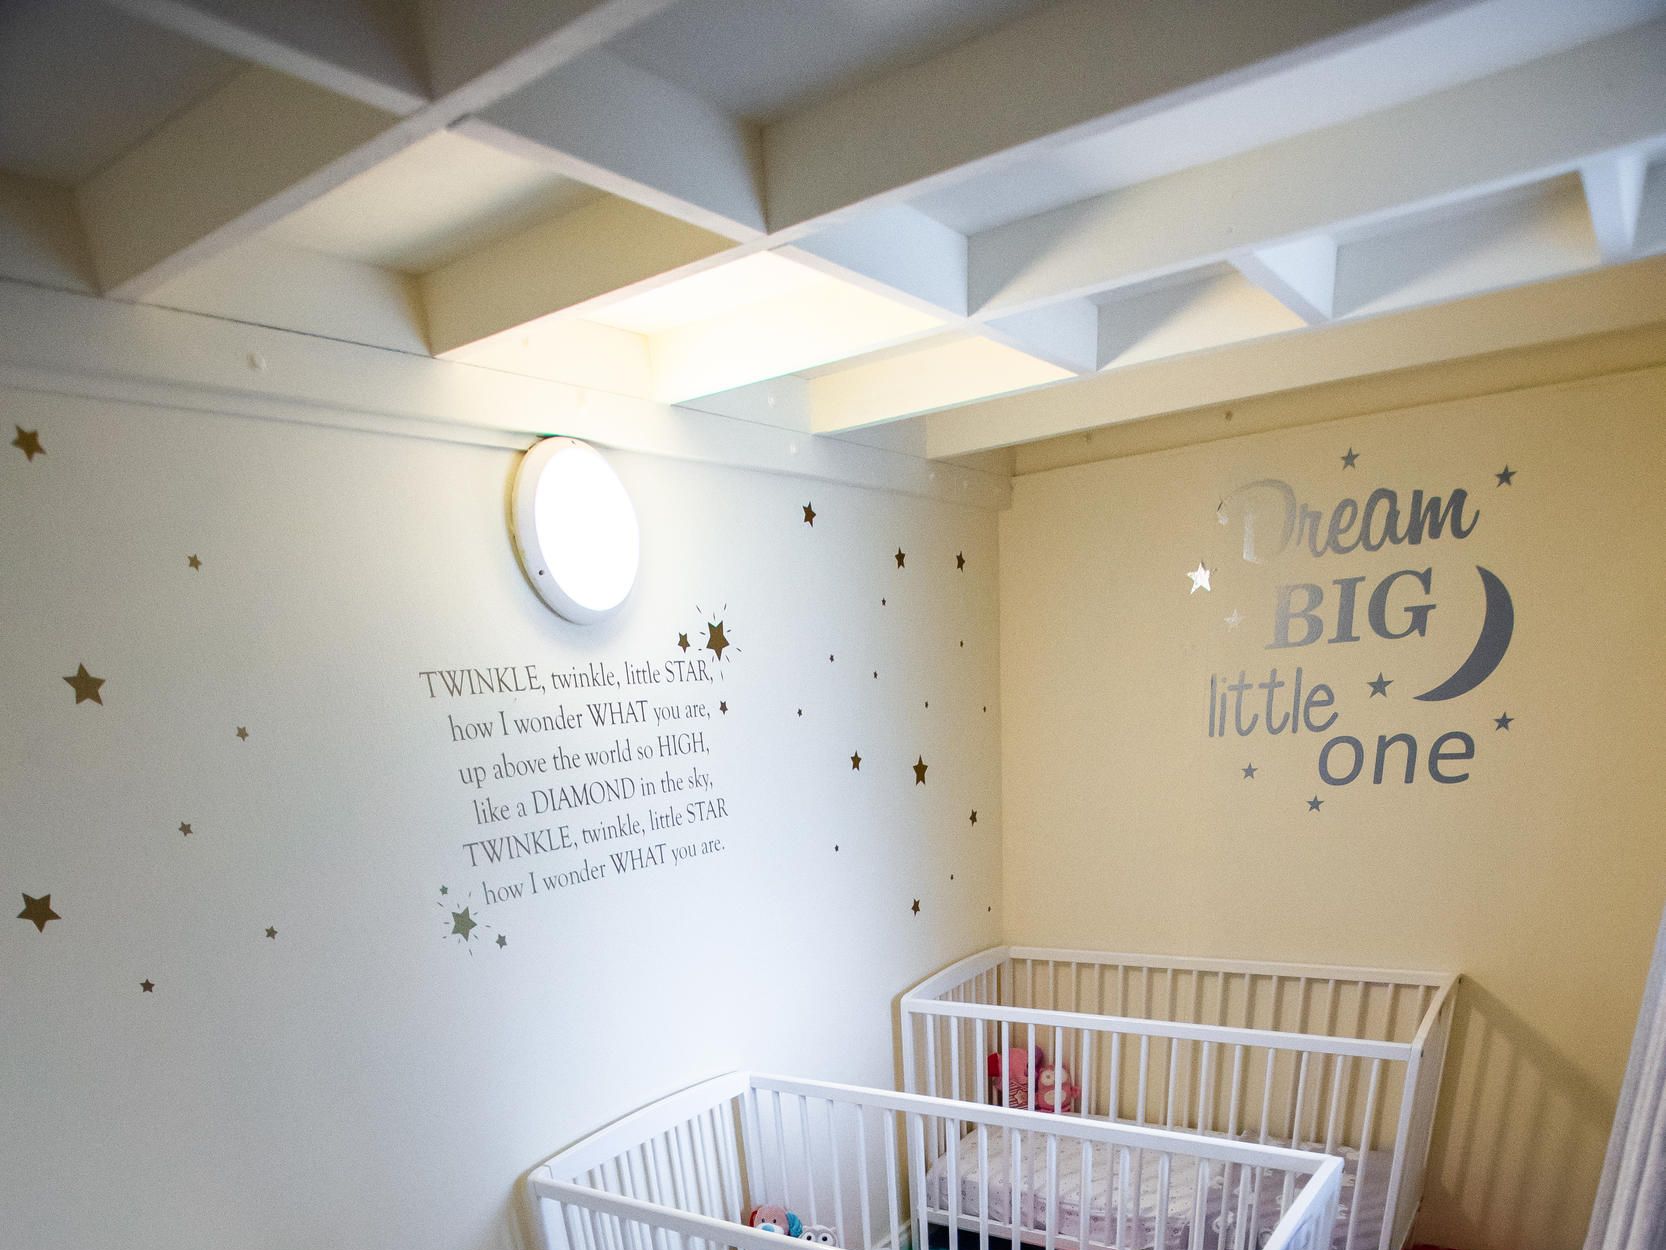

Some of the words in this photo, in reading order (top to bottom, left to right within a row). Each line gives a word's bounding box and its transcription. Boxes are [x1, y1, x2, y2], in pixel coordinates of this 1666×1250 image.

[1217, 478, 1480, 564] Dream
[1265, 567, 1437, 650] BIG
[419, 665, 545, 698] TWINKLE,
[551, 662, 620, 689] twinkle,
[624, 660, 660, 685] little
[665, 660, 714, 684] STAR,
[1208, 666, 1339, 737] little
[448, 714, 493, 742] how
[498, 711, 509, 736] I
[514, 704, 582, 734] wonder
[586, 700, 648, 727] WHAT
[654, 705, 680, 727] you
[685, 704, 710, 720] are,
[458, 766, 486, 789] up
[493, 752, 547, 779] above
[552, 746, 581, 771] the
[585, 738, 632, 766] world
[637, 745, 653, 760] so
[657, 732, 709, 757] HIGH,
[1317, 731, 1475, 786] one
[473, 797, 511, 824] like
[517, 802, 527, 817] a
[531, 777, 635, 814] DIAMOND
[641, 777, 656, 796] in
[661, 770, 683, 793] the
[688, 766, 713, 791] sky,
[463, 825, 577, 867] TWINKLE,
[582, 813, 645, 844] twinkle,
[649, 806, 682, 830] little
[687, 798, 728, 823] STAR
[482, 881, 523, 905] how
[529, 872, 538, 894] I
[542, 858, 606, 890] wonder
[609, 843, 666, 874] WHAT
[672, 844, 696, 866] you
[701, 840, 724, 854] are.
